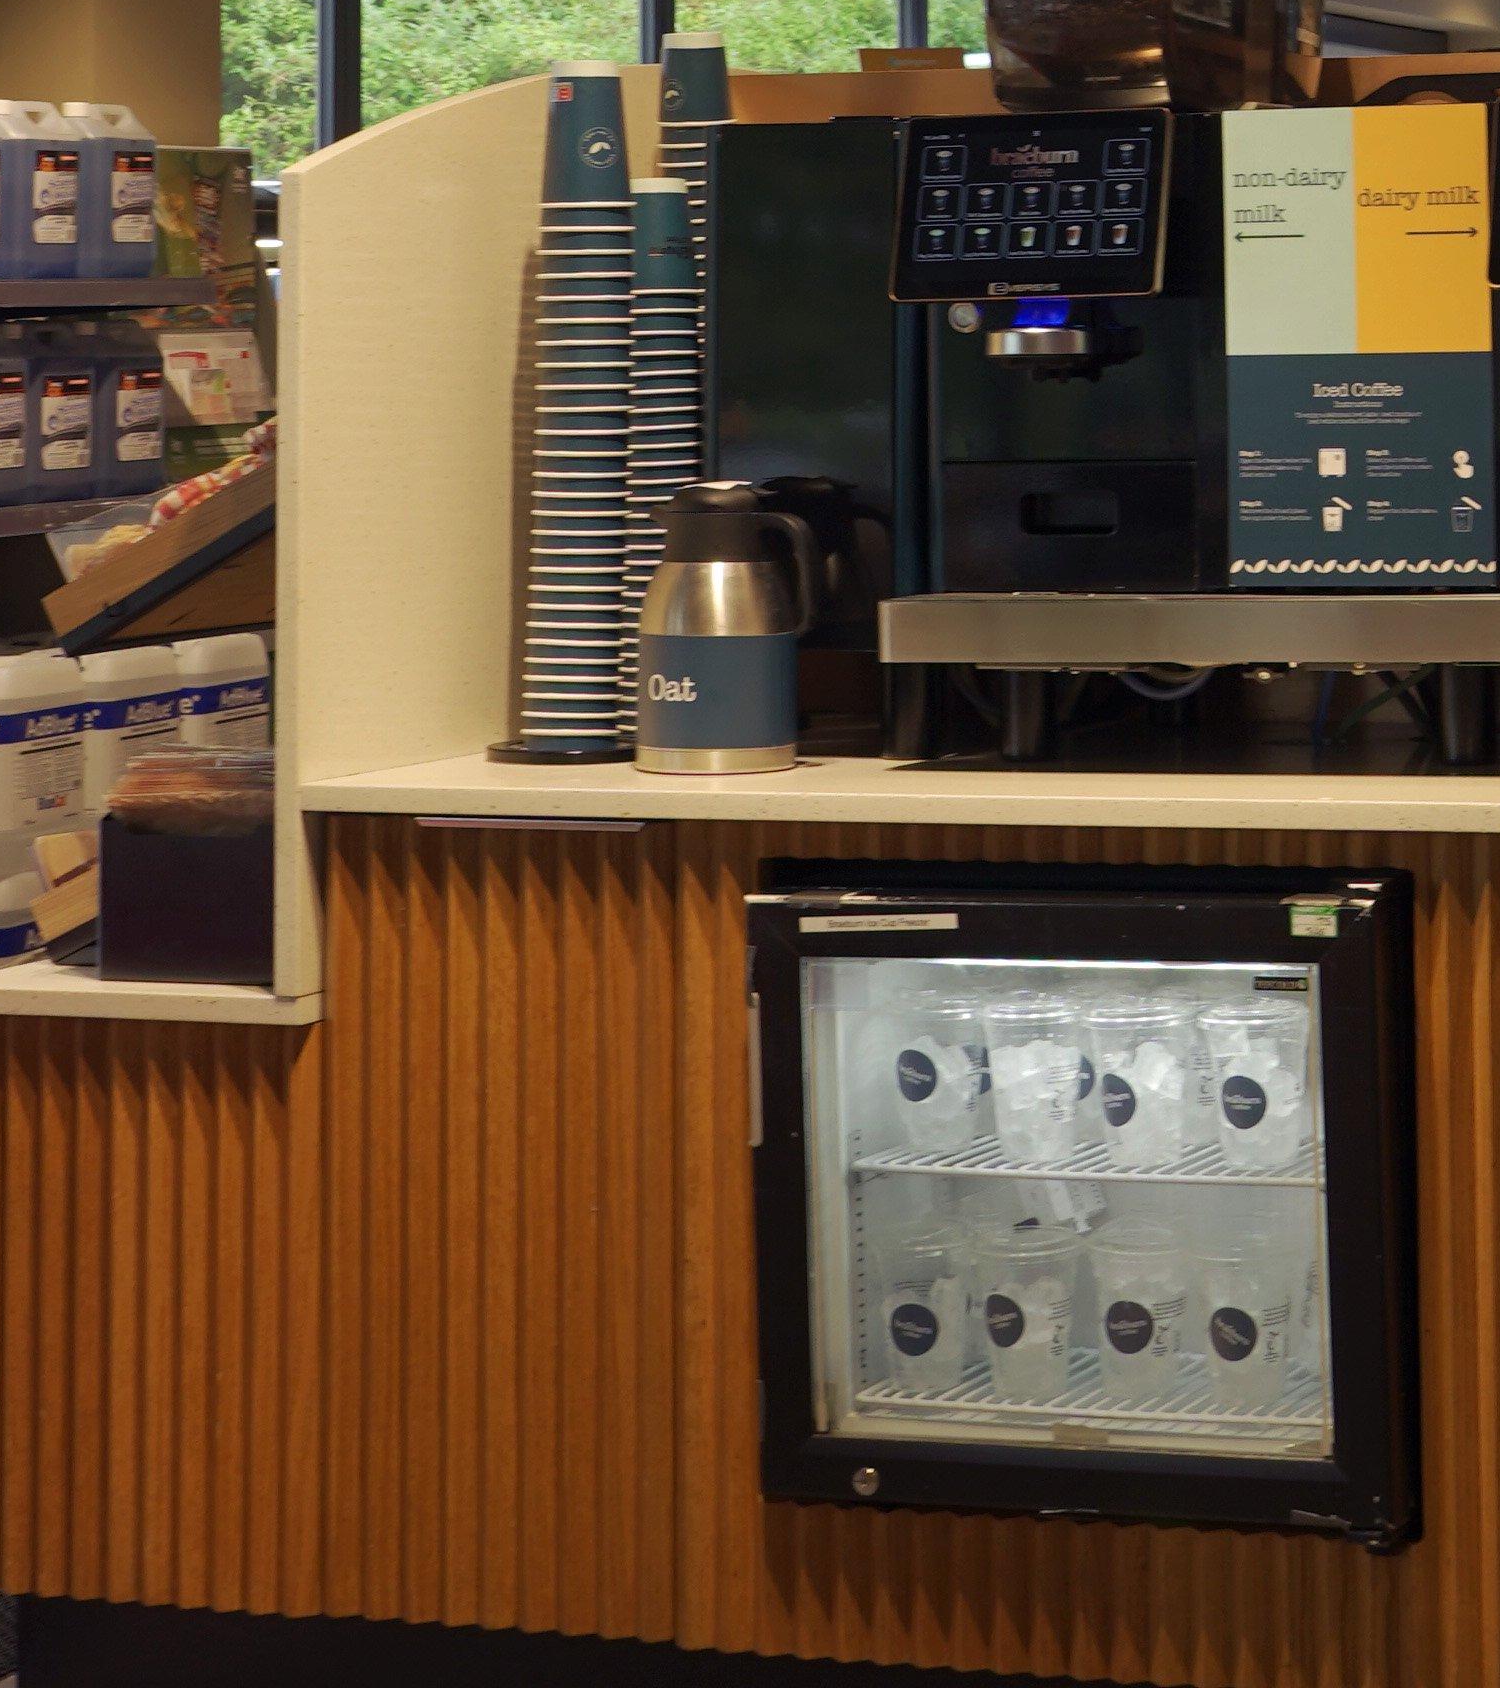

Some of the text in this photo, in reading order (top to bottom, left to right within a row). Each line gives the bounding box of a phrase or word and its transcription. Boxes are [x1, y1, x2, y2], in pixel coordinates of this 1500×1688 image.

[1233, 167, 1347, 190] non-dairy
[1357, 185, 1480, 211] dairy milk
[1233, 204, 1287, 223] milk
[1312, 382, 1349, 398] Iced
[647, 673, 699, 703] Oat
